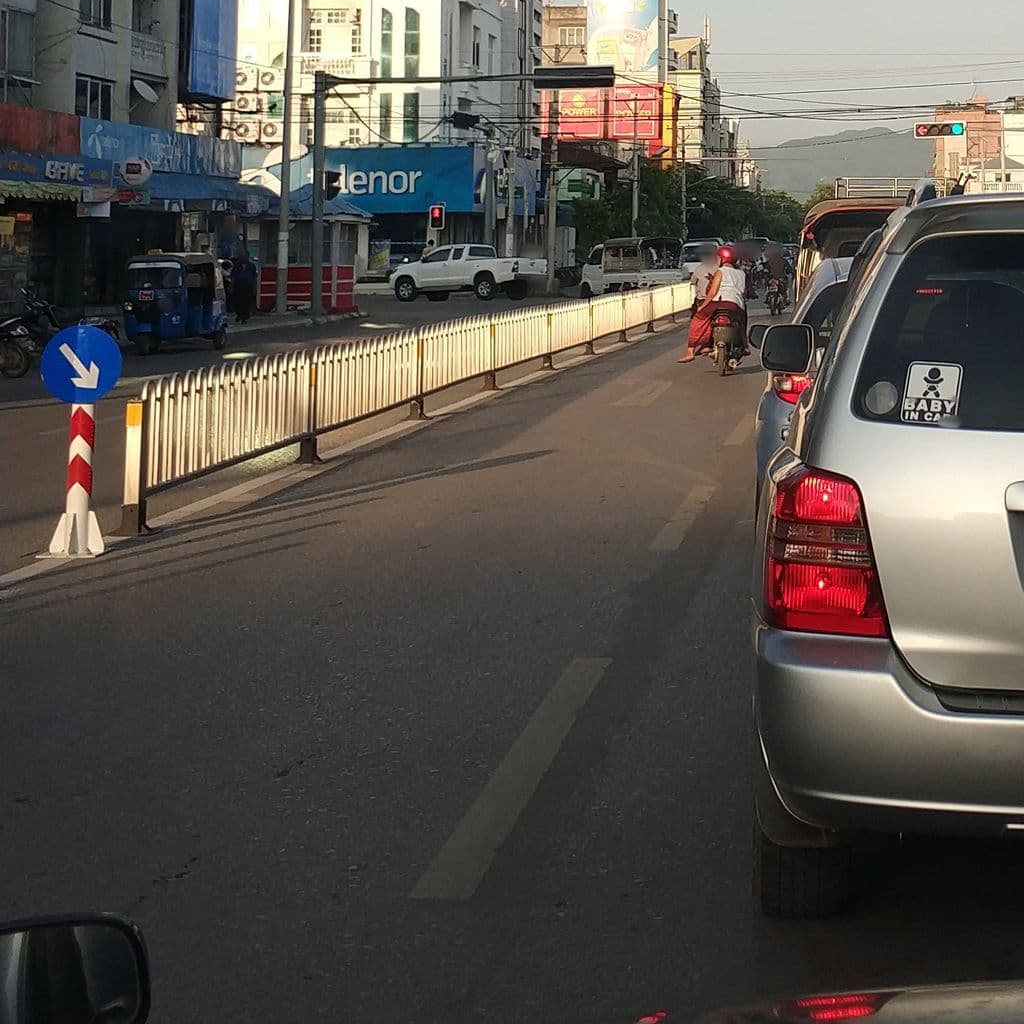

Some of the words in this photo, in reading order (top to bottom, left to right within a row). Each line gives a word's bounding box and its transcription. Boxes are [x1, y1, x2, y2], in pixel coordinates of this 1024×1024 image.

[561, 107, 597, 116] POWER
[306, 163, 423, 195] lenor
[903, 398, 956, 413] BABY
[904, 411, 919, 421] IN
